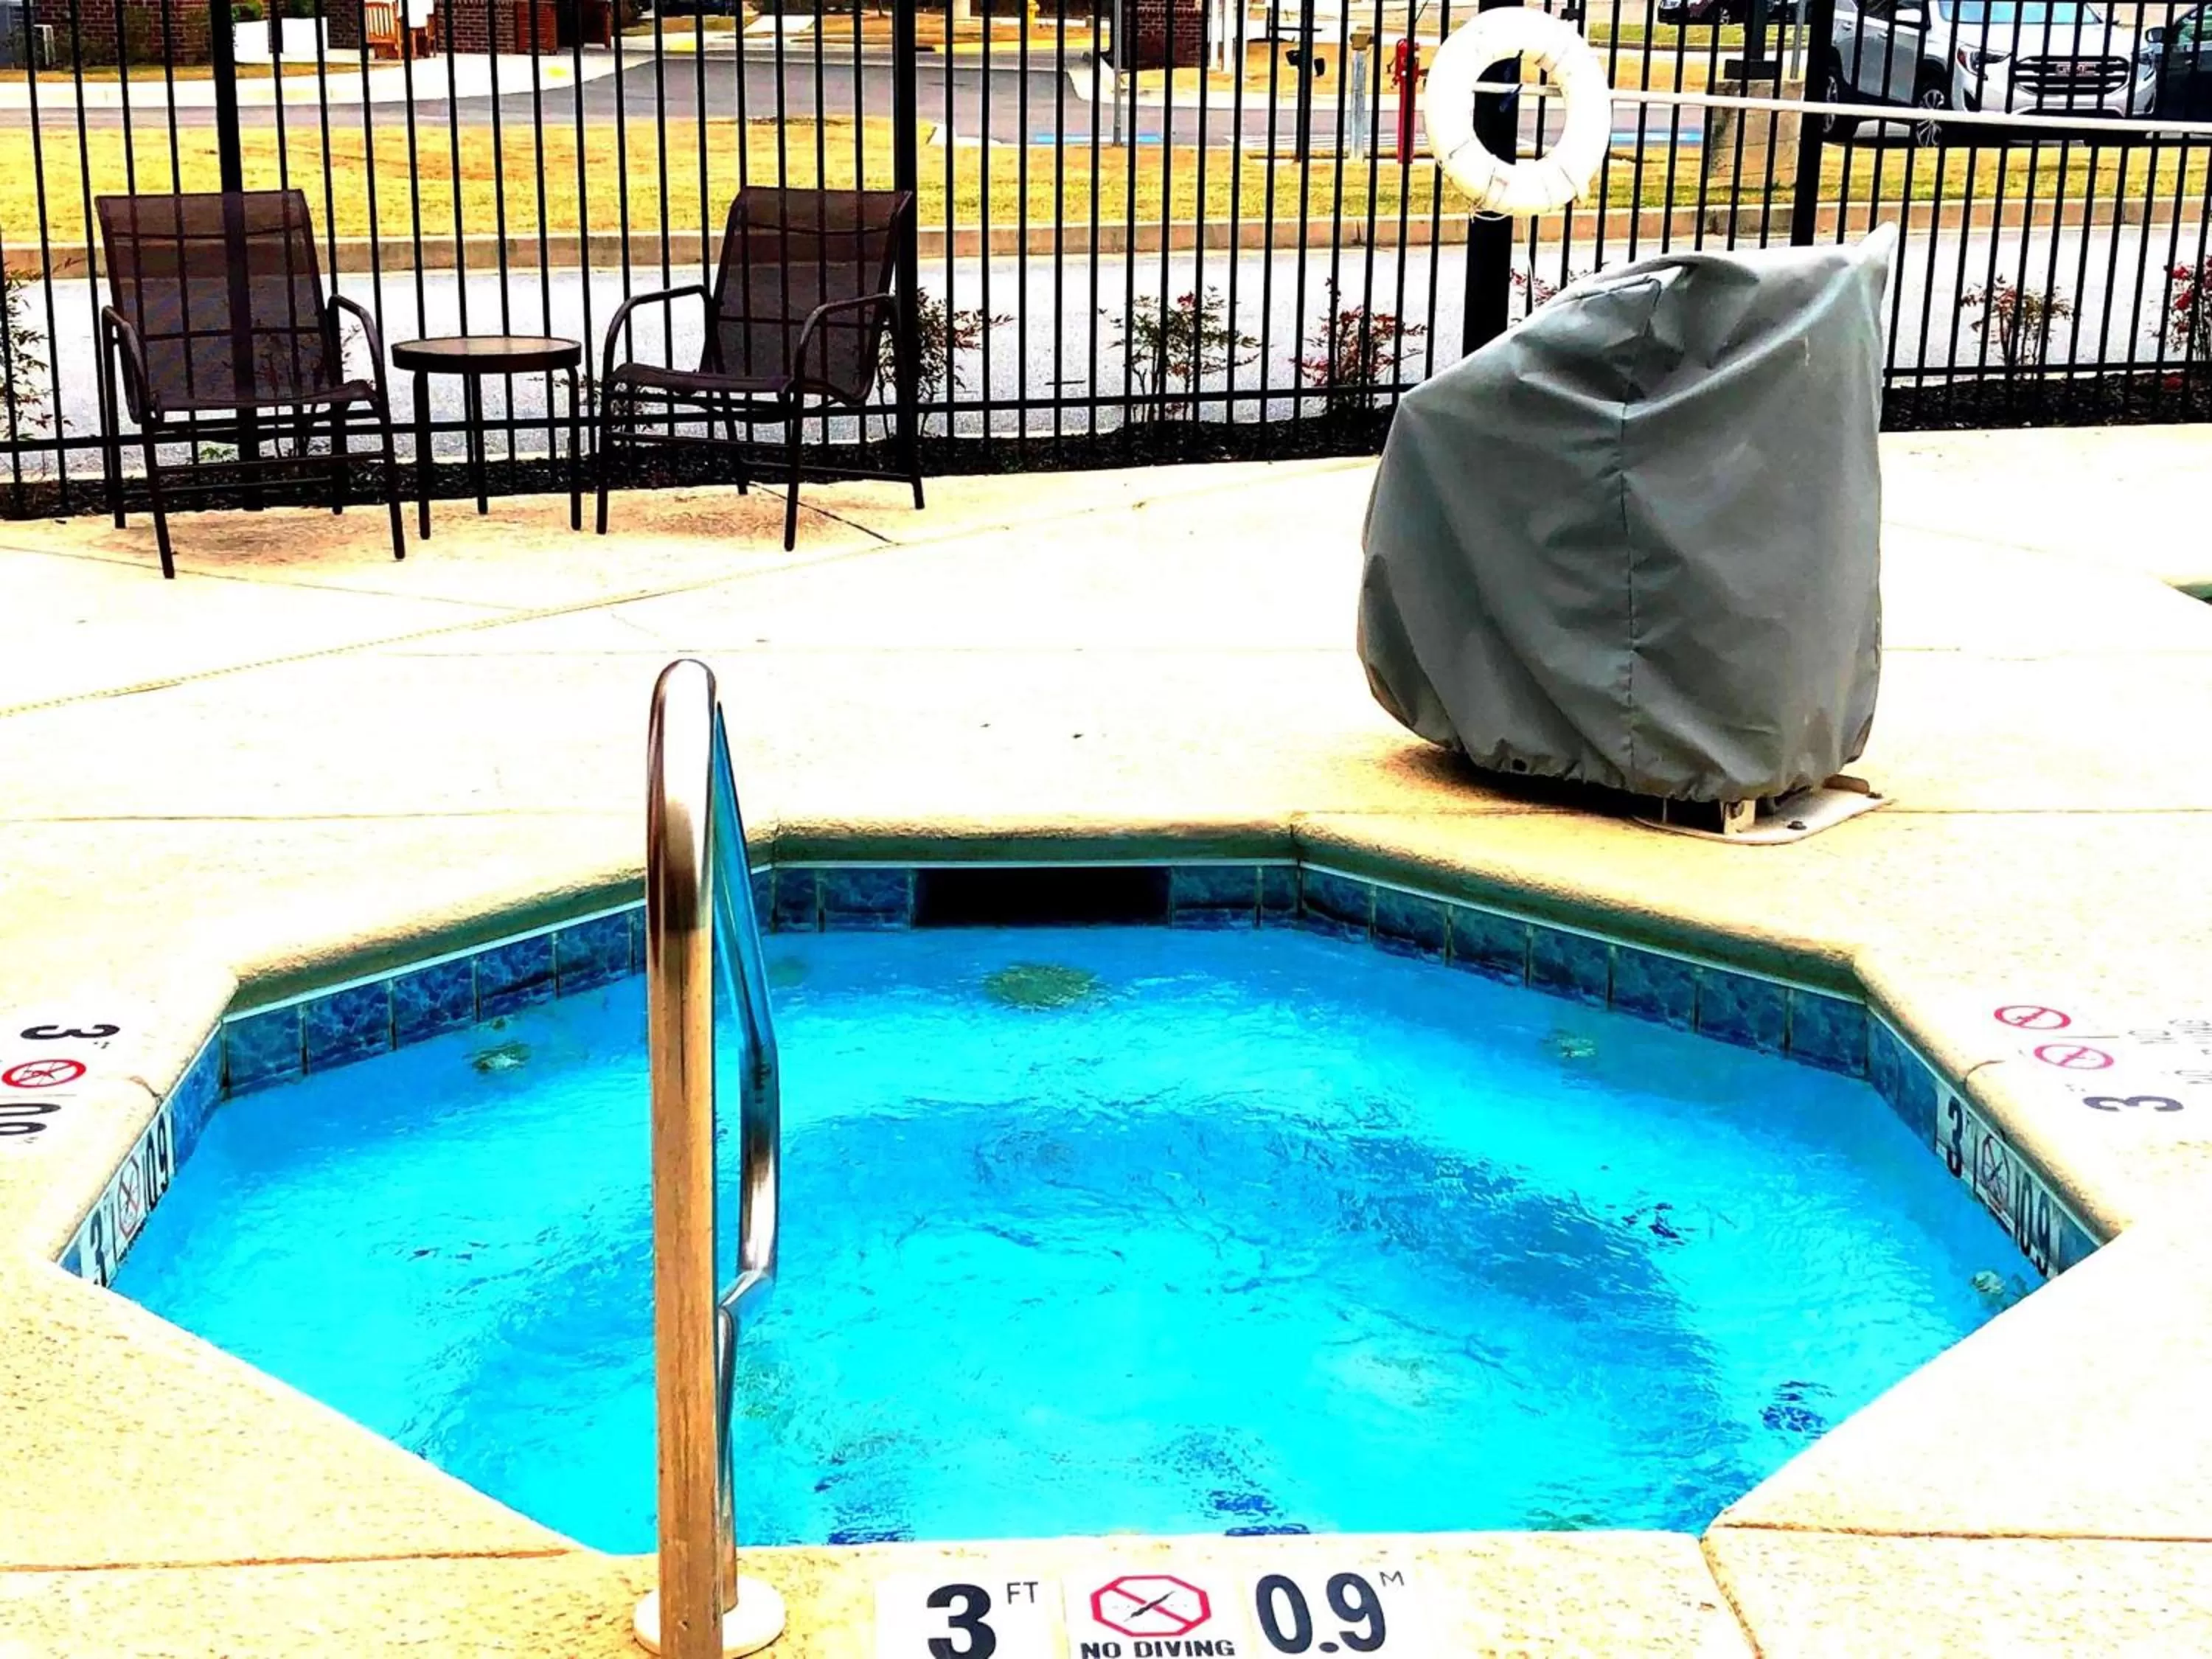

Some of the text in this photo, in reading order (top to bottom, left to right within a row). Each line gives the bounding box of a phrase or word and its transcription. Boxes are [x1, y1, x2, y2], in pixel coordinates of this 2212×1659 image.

[20, 1024, 120, 1040] 3
[2083, 1096, 2184, 1112] 3
[1947, 1096, 1963, 1179] 3
[927, 1571, 1405, 1659] 3 FT 0.9 M
[1080, 1639, 1236, 1659] NO DIVING
